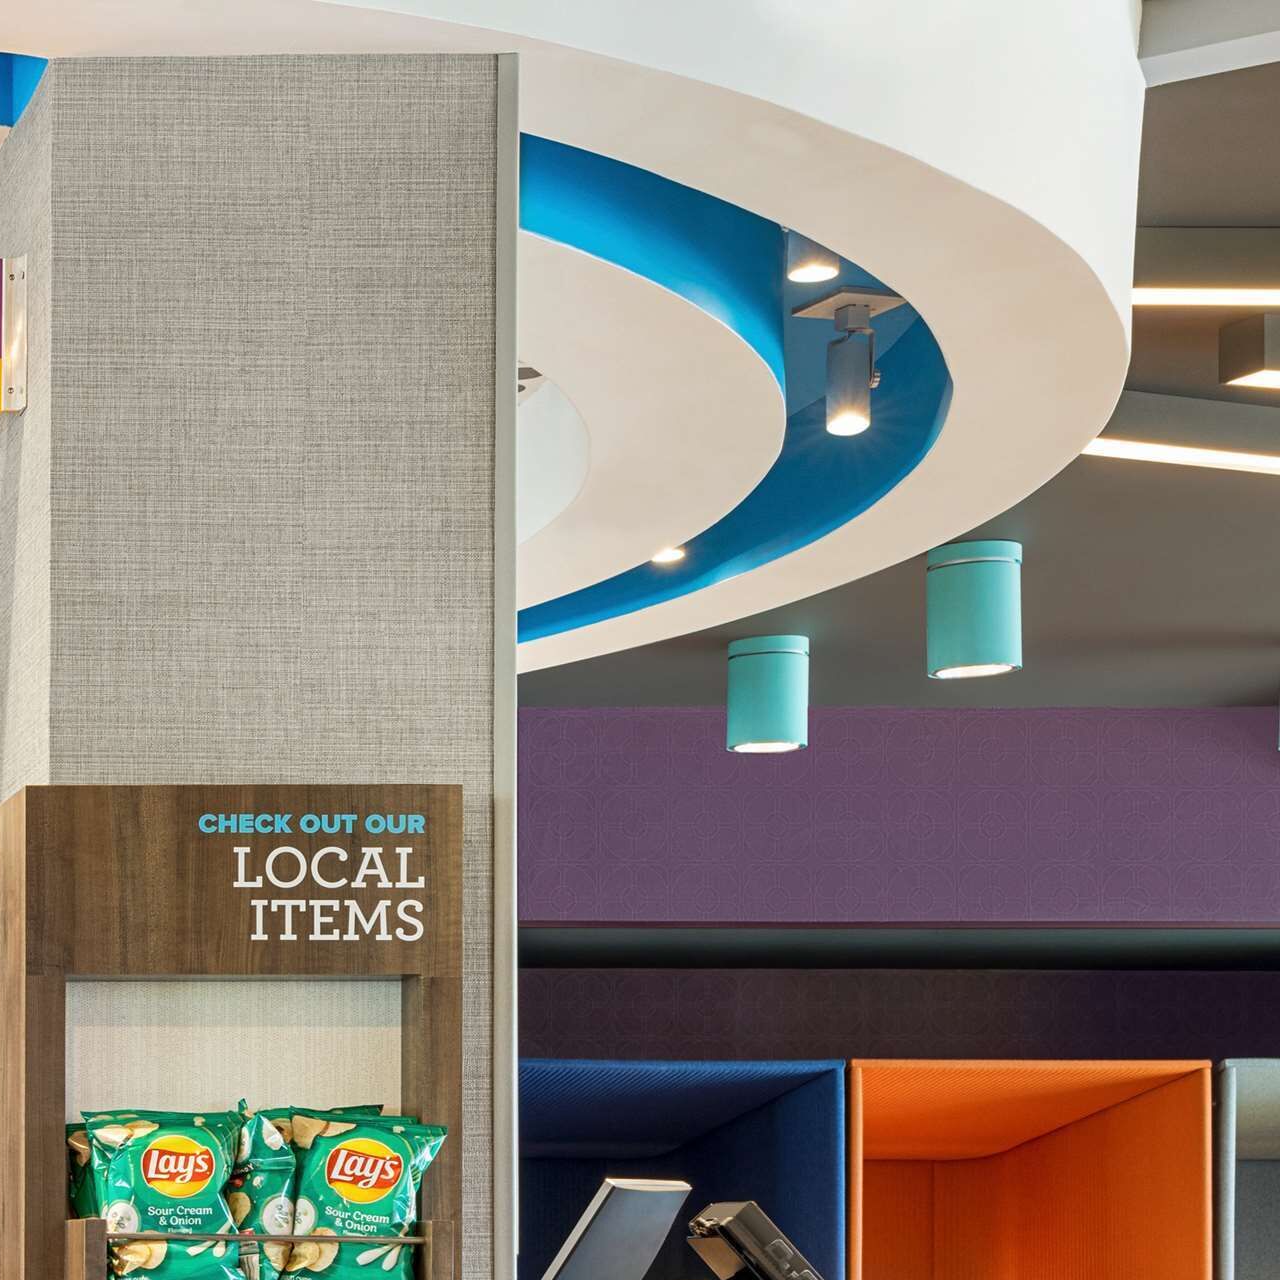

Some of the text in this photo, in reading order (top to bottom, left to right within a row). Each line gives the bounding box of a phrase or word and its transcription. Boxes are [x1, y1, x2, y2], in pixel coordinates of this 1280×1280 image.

[197, 813, 426, 835] CHECK OUT OUR
[232, 846, 426, 889] LOCAL
[249, 899, 425, 942] ITEMS
[147, 1150, 211, 1183] Lay's
[330, 1151, 400, 1187] Lay's
[147, 1205, 213, 1217] Sour Cream
[159, 1215, 202, 1227] & Onion
[324, 1205, 390, 1225] Sour Cream
[334, 1218, 378, 1234] & Onion
